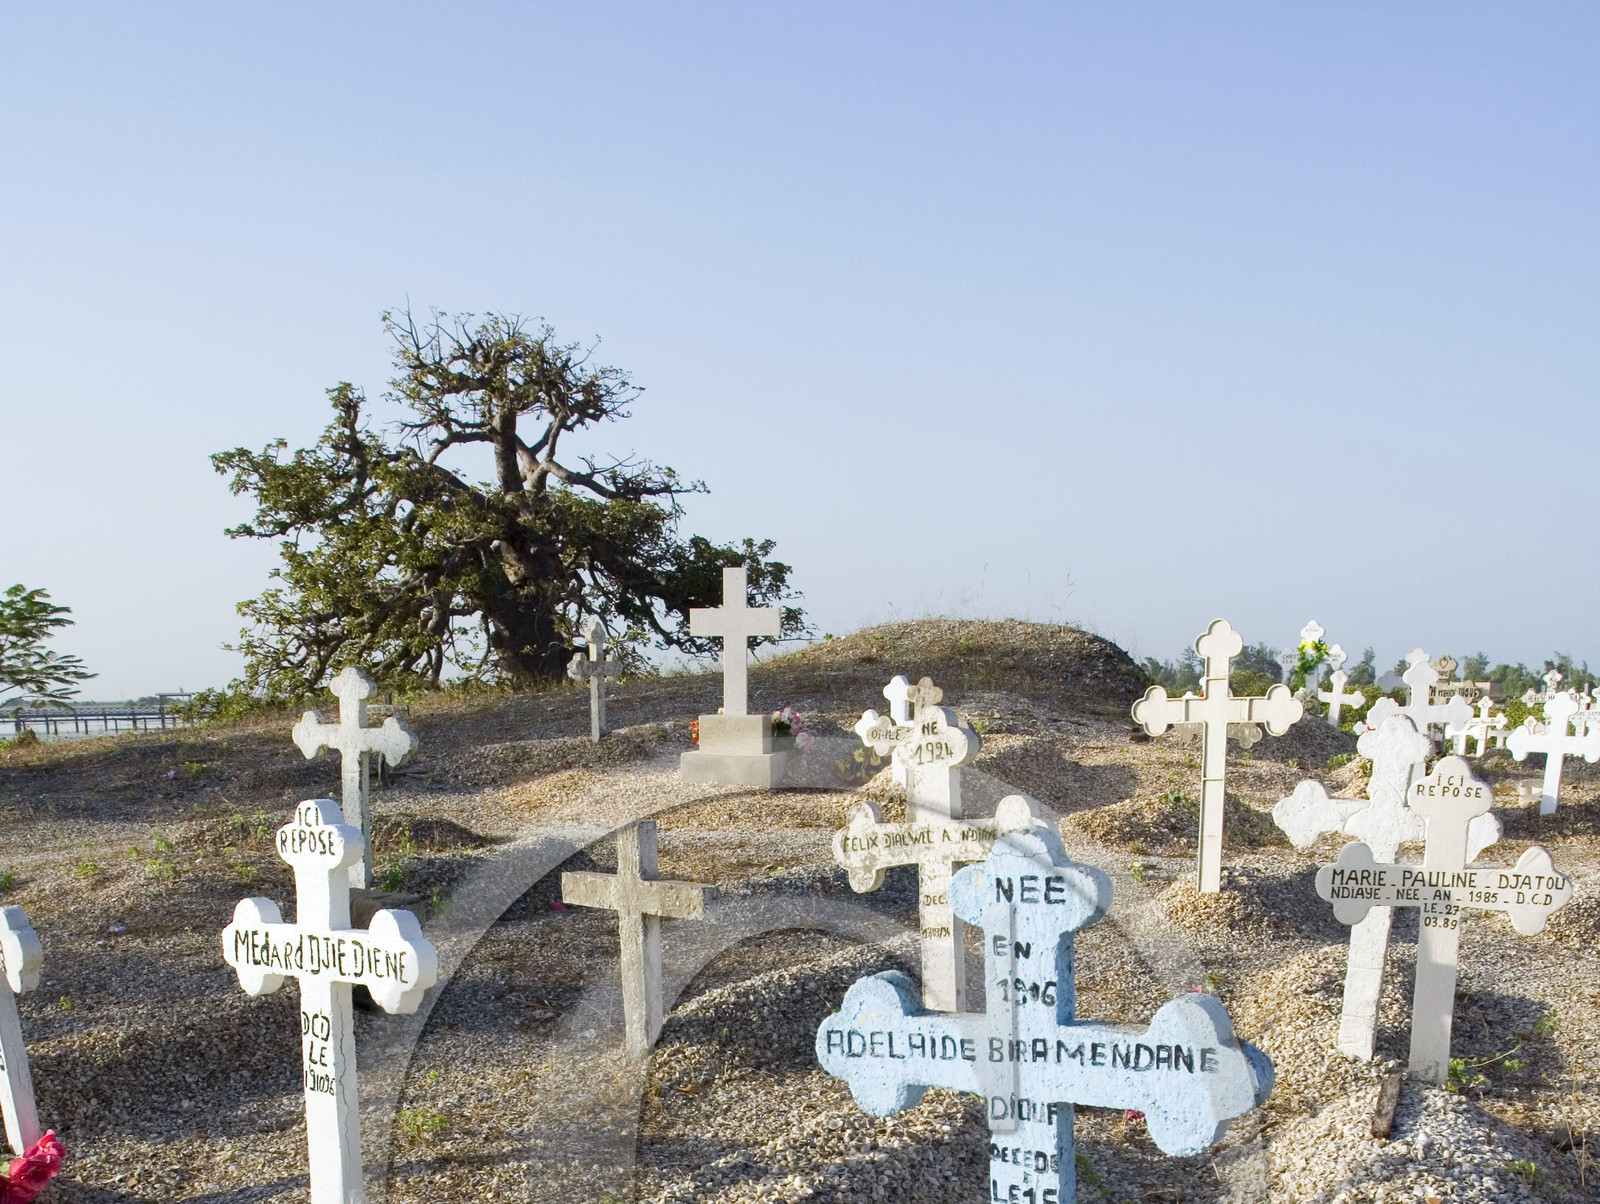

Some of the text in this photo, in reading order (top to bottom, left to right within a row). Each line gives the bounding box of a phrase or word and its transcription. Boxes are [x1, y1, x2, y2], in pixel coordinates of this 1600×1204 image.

[921, 721, 939, 736] NE
[910, 741, 955, 766] 1924
[1416, 784, 1483, 799] REPOSE
[280, 828, 336, 856] REPOSE
[995, 875, 1067, 905] NEE
[1497, 873, 1567, 891] DJATOU
[1396, 888, 1419, 901] NEE
[1433, 888, 1451, 901] AN
[1468, 890, 1499, 904] 1985
[993, 935, 1032, 959] EN
[308, 1040, 328, 1067] LE
